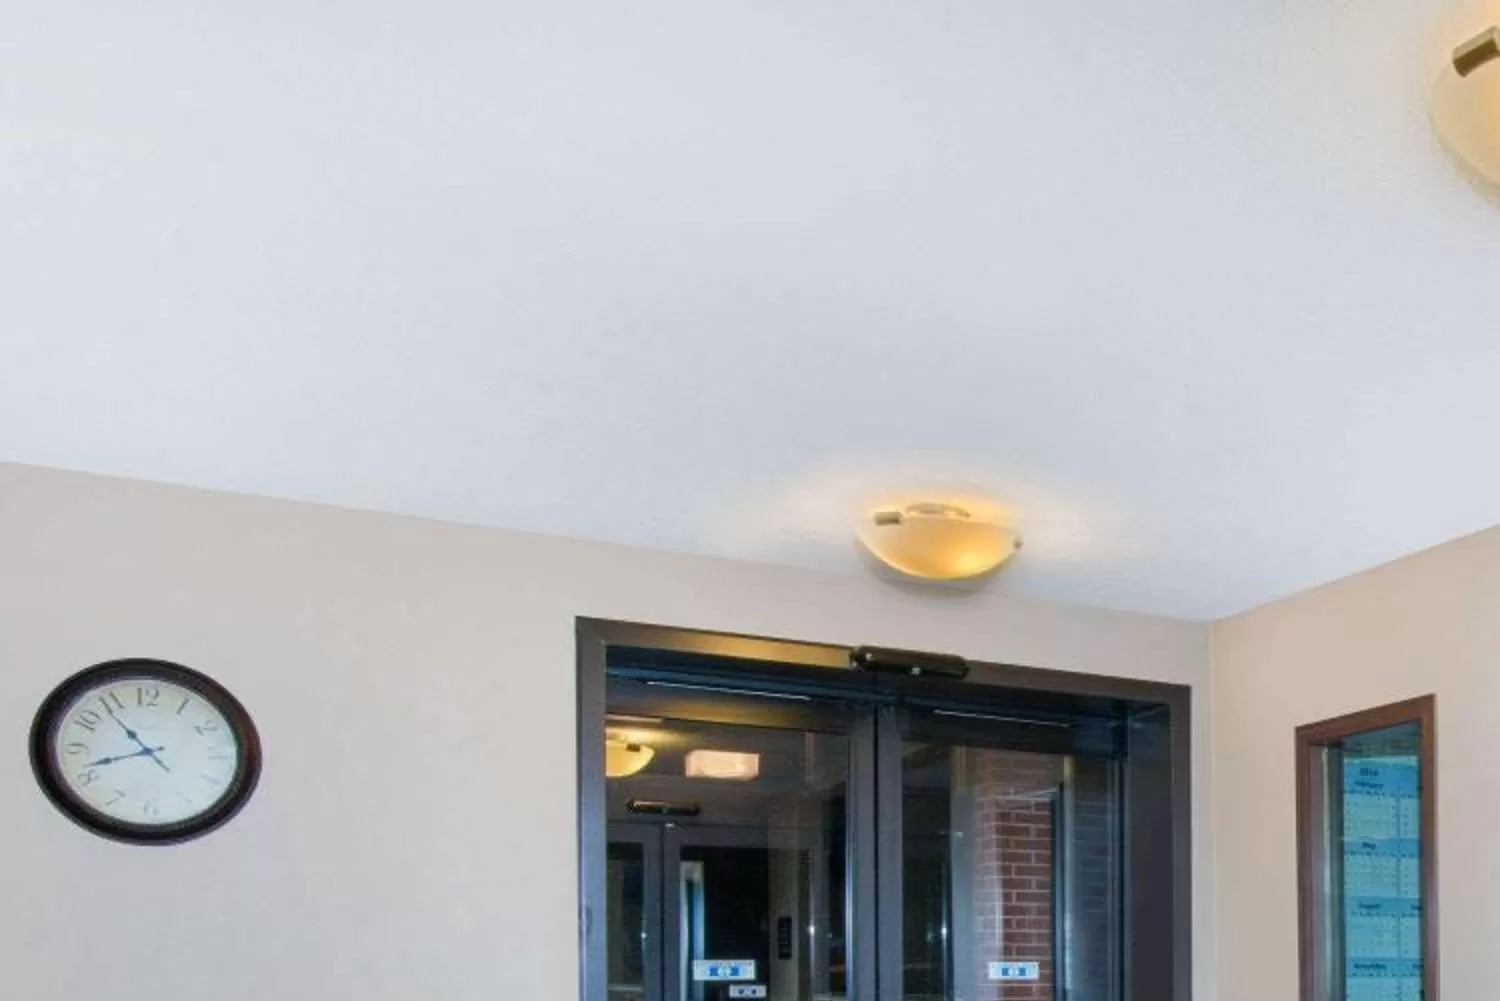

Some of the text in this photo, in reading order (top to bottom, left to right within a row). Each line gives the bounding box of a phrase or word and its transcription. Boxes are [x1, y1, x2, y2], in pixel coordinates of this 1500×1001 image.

[99, 691, 125, 714] 11
[136, 687, 159, 707] 12
[176, 698, 190, 716] 1
[74, 709, 101, 732] 10
[193, 719, 218, 736] 2
[67, 742, 89, 755] 9
[77, 768, 99, 787] 8
[105, 789, 126, 807] 7
